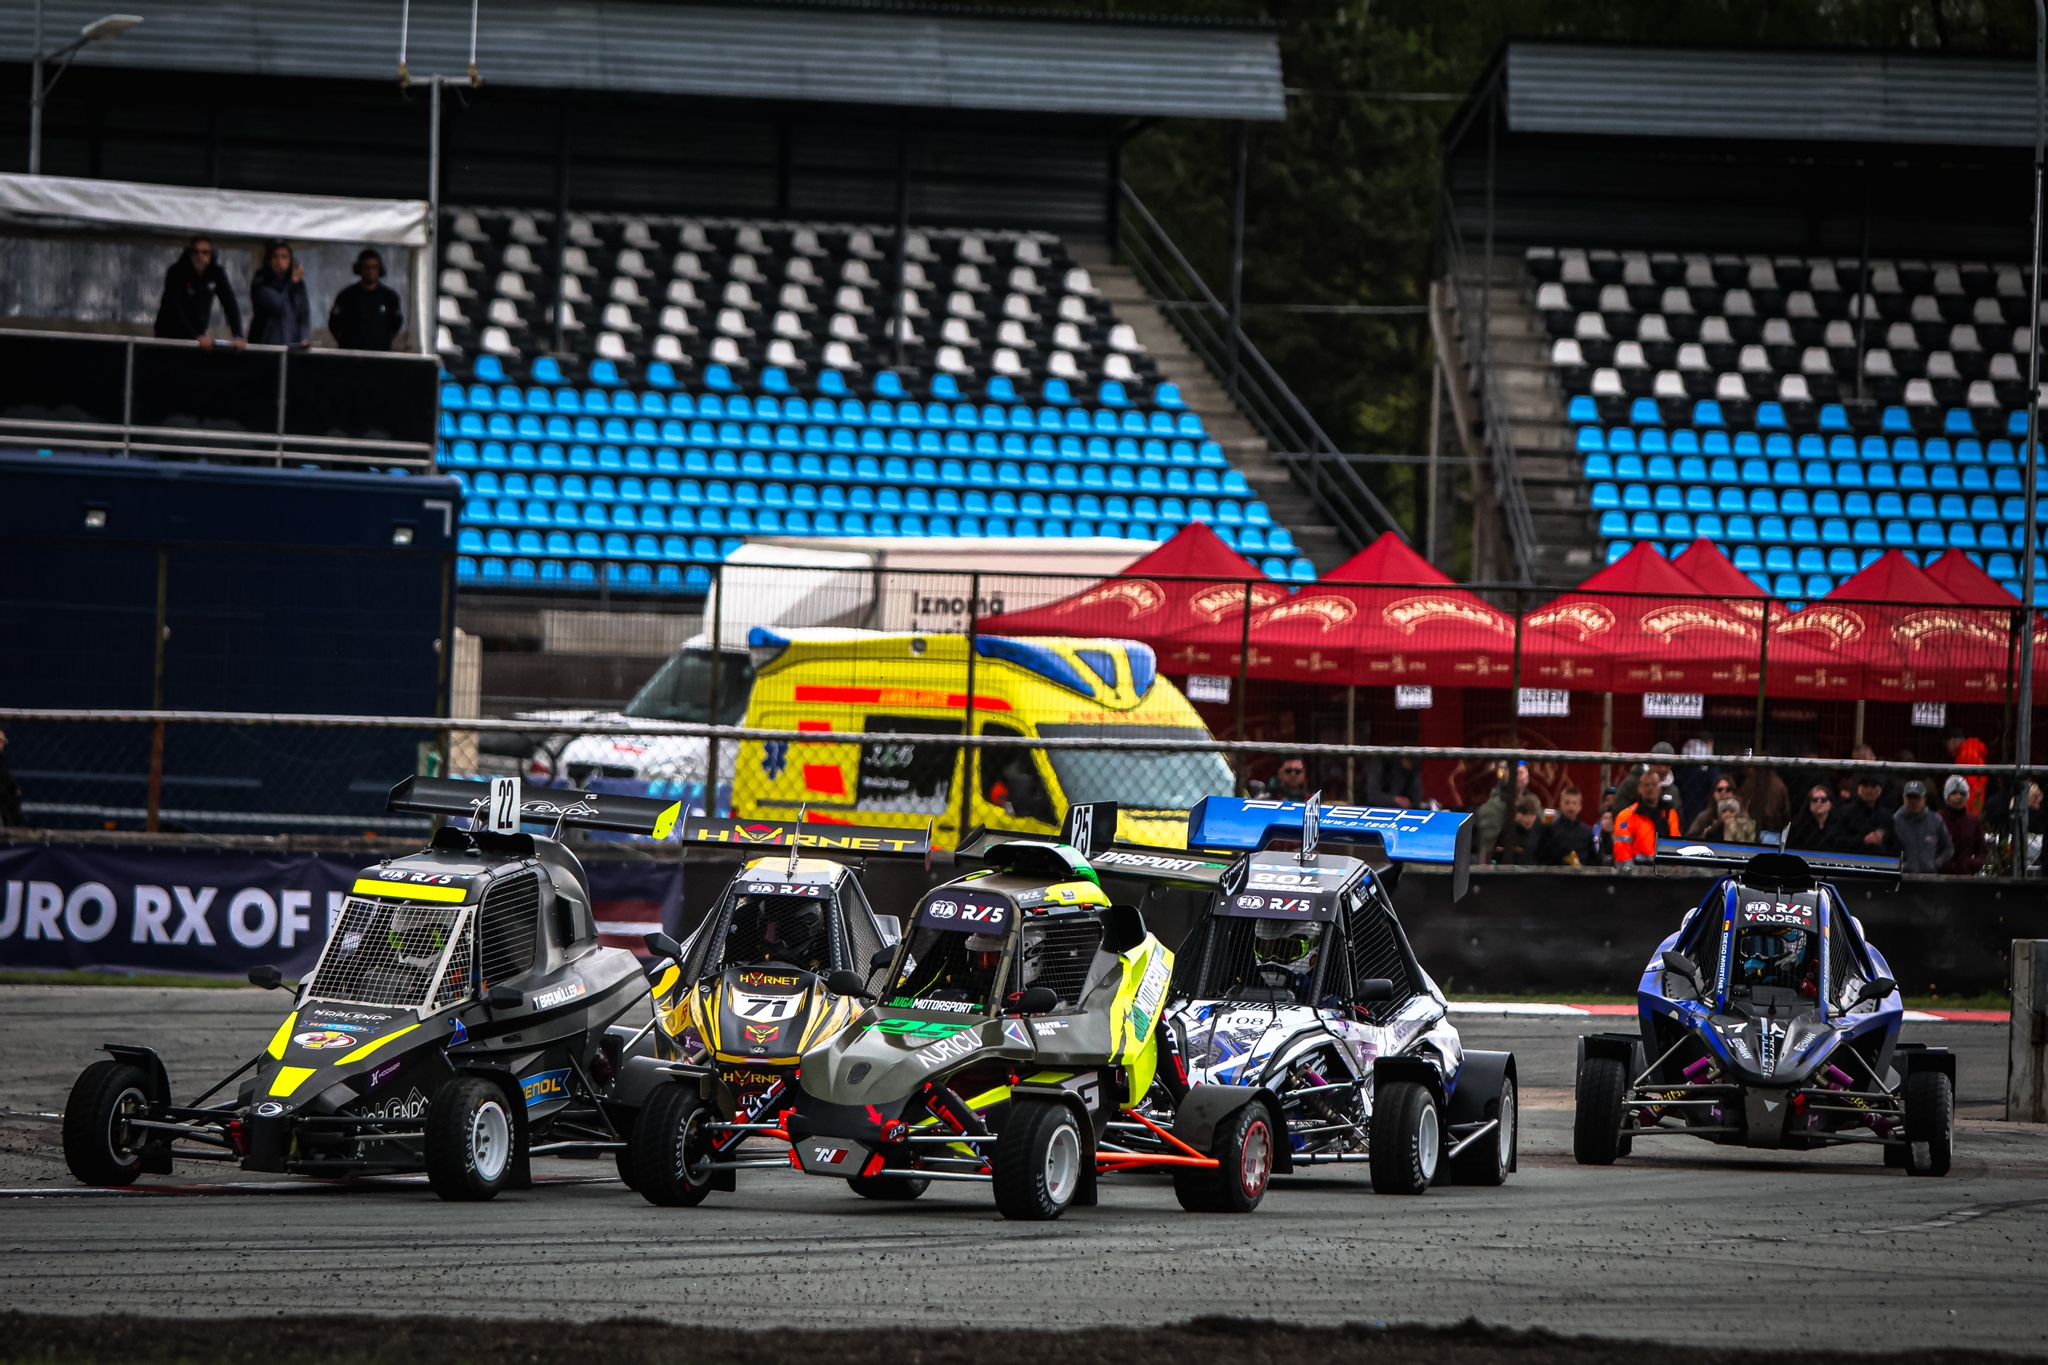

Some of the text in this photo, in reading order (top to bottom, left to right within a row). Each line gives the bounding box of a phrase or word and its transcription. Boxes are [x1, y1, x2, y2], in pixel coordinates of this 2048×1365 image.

[497, 779, 514, 829] 22
[1073, 807, 1091, 853] 25
[410, 872, 454, 885] RX5
[748, 884, 819, 895] FIA RX5
[930, 901, 1004, 923] FIA RX5
[1237, 896, 1310, 912] FIA RX5
[1745, 902, 1813, 916] FIA RX5
[131, 884, 218, 945] RX
[228, 887, 312, 947] OF
[743, 999, 788, 1017] 71
[862, 1018, 973, 1039] 25
[1226, 1017, 1264, 1025] 108
[724, 1070, 781, 1086] HORNE
[674, 1117, 686, 1181] Hoosier
